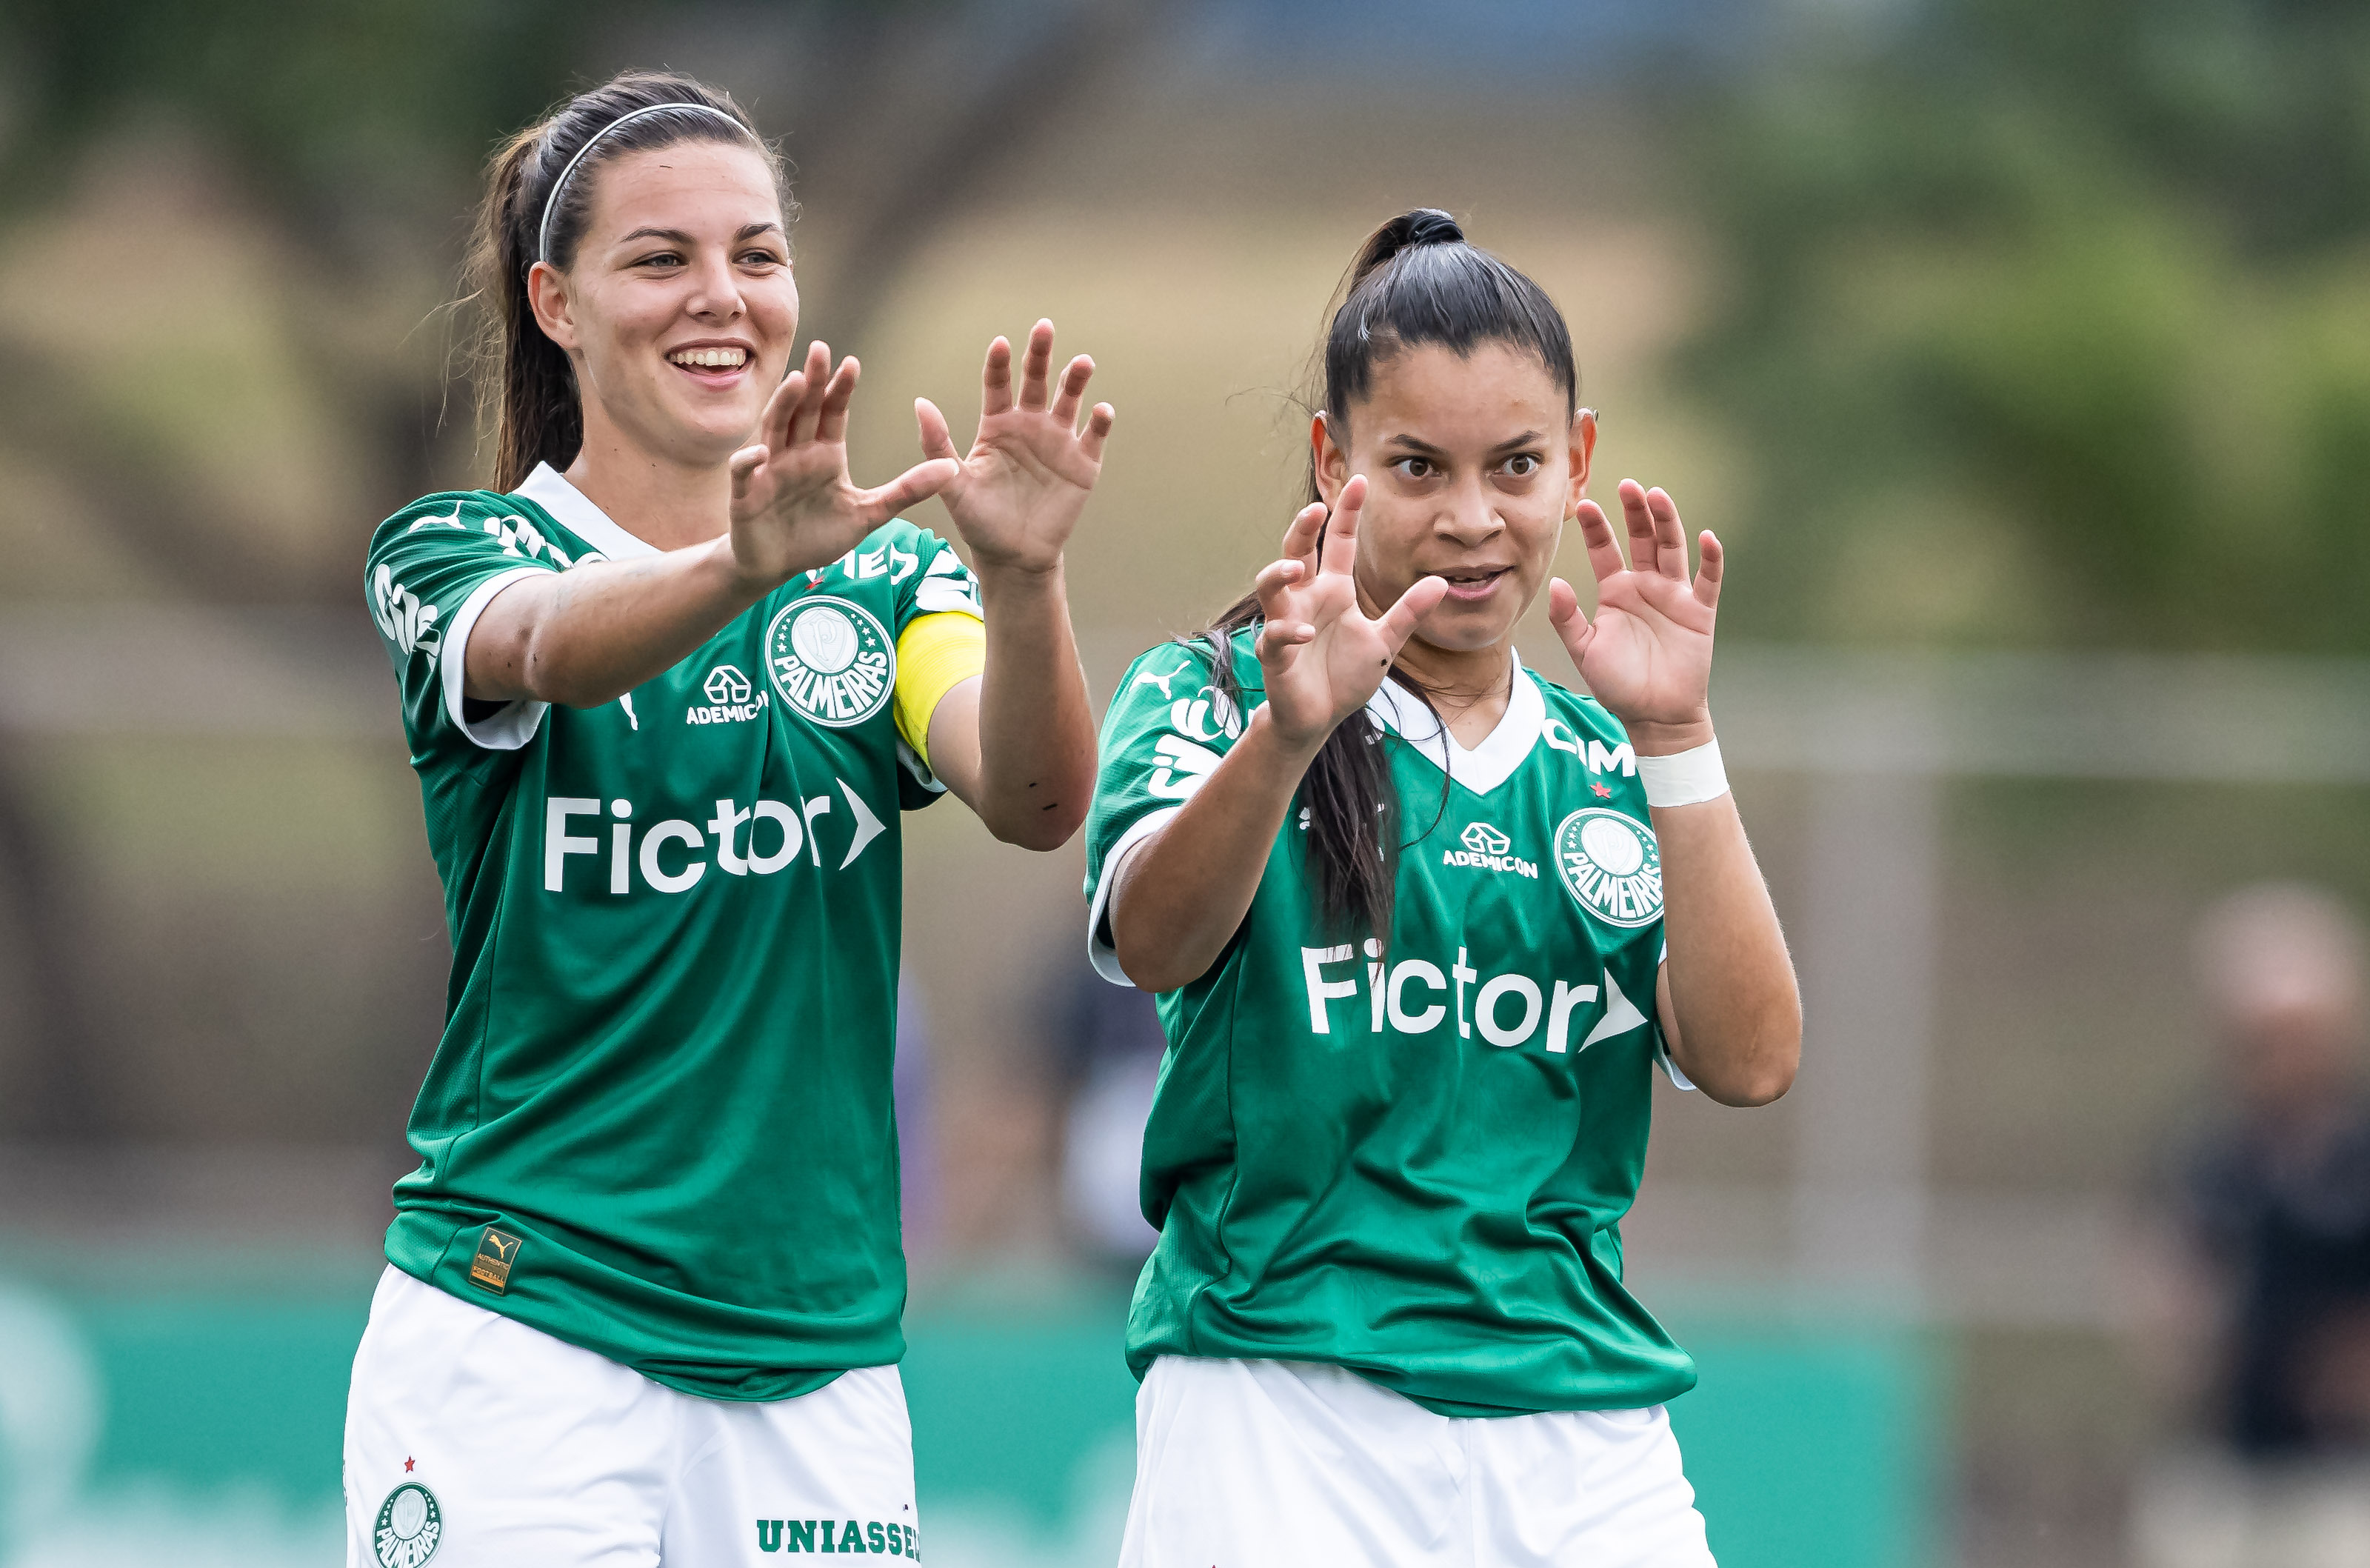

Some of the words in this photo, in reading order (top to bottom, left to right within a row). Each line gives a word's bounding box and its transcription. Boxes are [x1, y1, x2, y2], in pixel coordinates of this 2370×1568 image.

[773, 651, 887, 719] PALMEIRAS
[1541, 718, 1637, 778] CIM
[544, 795, 830, 894] Fictor
[1443, 850, 1538, 879] ADEMICON
[1563, 852, 1664, 918] PALMEIRAS
[1301, 938, 1599, 1054] Fictor
[376, 1521, 440, 1568] PALMEIRAS
